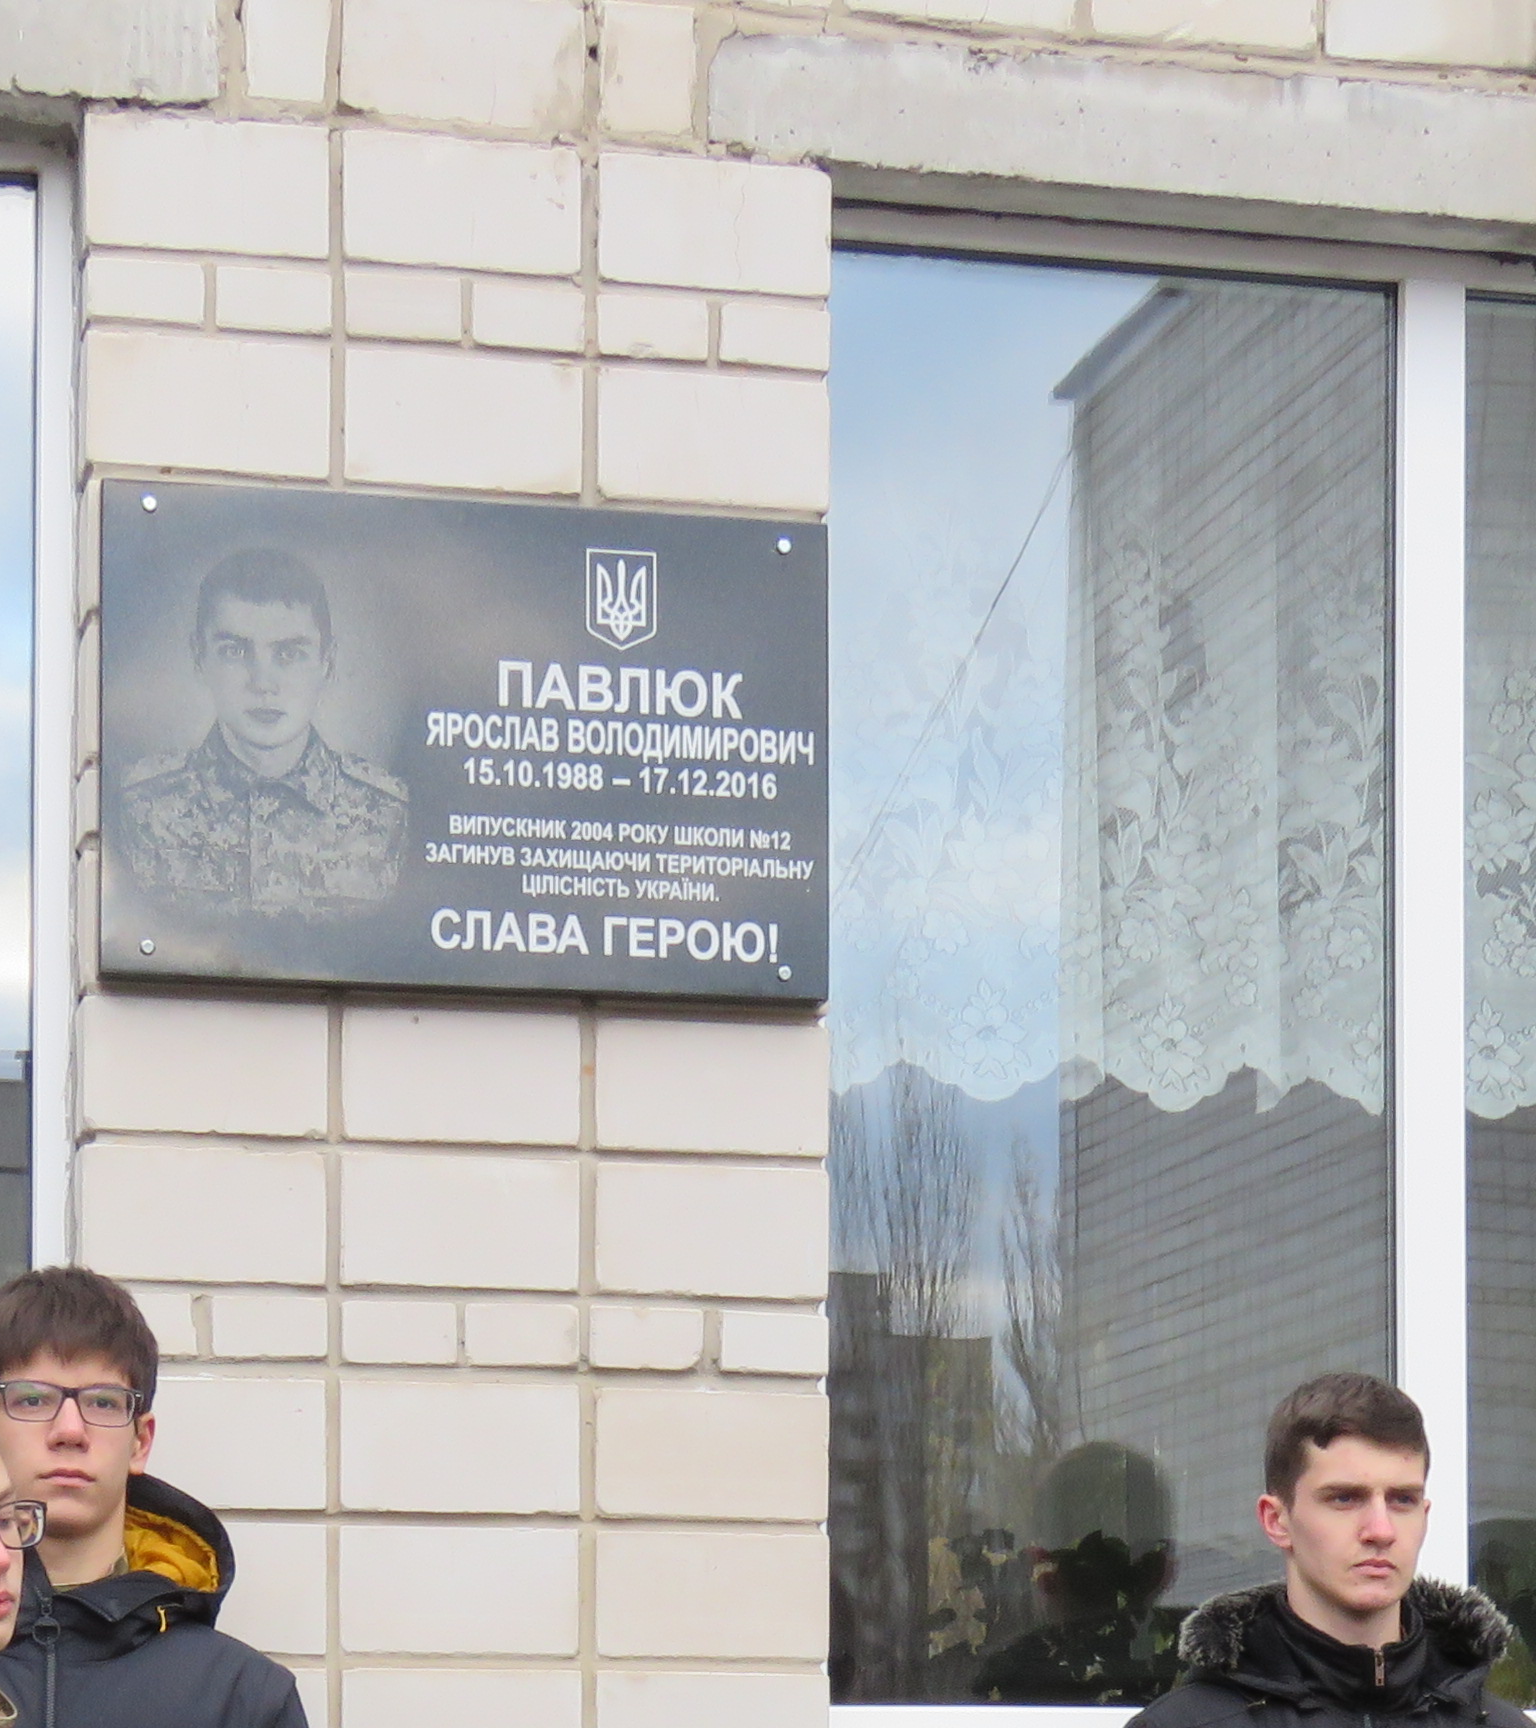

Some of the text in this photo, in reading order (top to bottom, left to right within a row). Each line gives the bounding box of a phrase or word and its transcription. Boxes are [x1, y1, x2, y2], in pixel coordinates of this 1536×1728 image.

[498, 660, 743, 719] ПАВЛЮК
[426, 711, 815, 765] ЯРОСЛАВ ВОЛОДИМИРОВИЧ
[464, 758, 603, 790] 15.10.1988
[639, 767, 777, 800] 17.12.2016
[449, 815, 791, 850] ВИПУСКНИК 2004 РОКУ ШКОЛИ №12
[425, 843, 814, 881] ЗАГИНУВ ЗАХИЩАЮЧИ ТЕРИТОРІАЛЬНУ
[522, 875, 720, 902] ЦІЛІСНІСТЬ УКРАЇНИ.
[430, 908, 778, 964] СЛАВА ГЕРОЮ!
